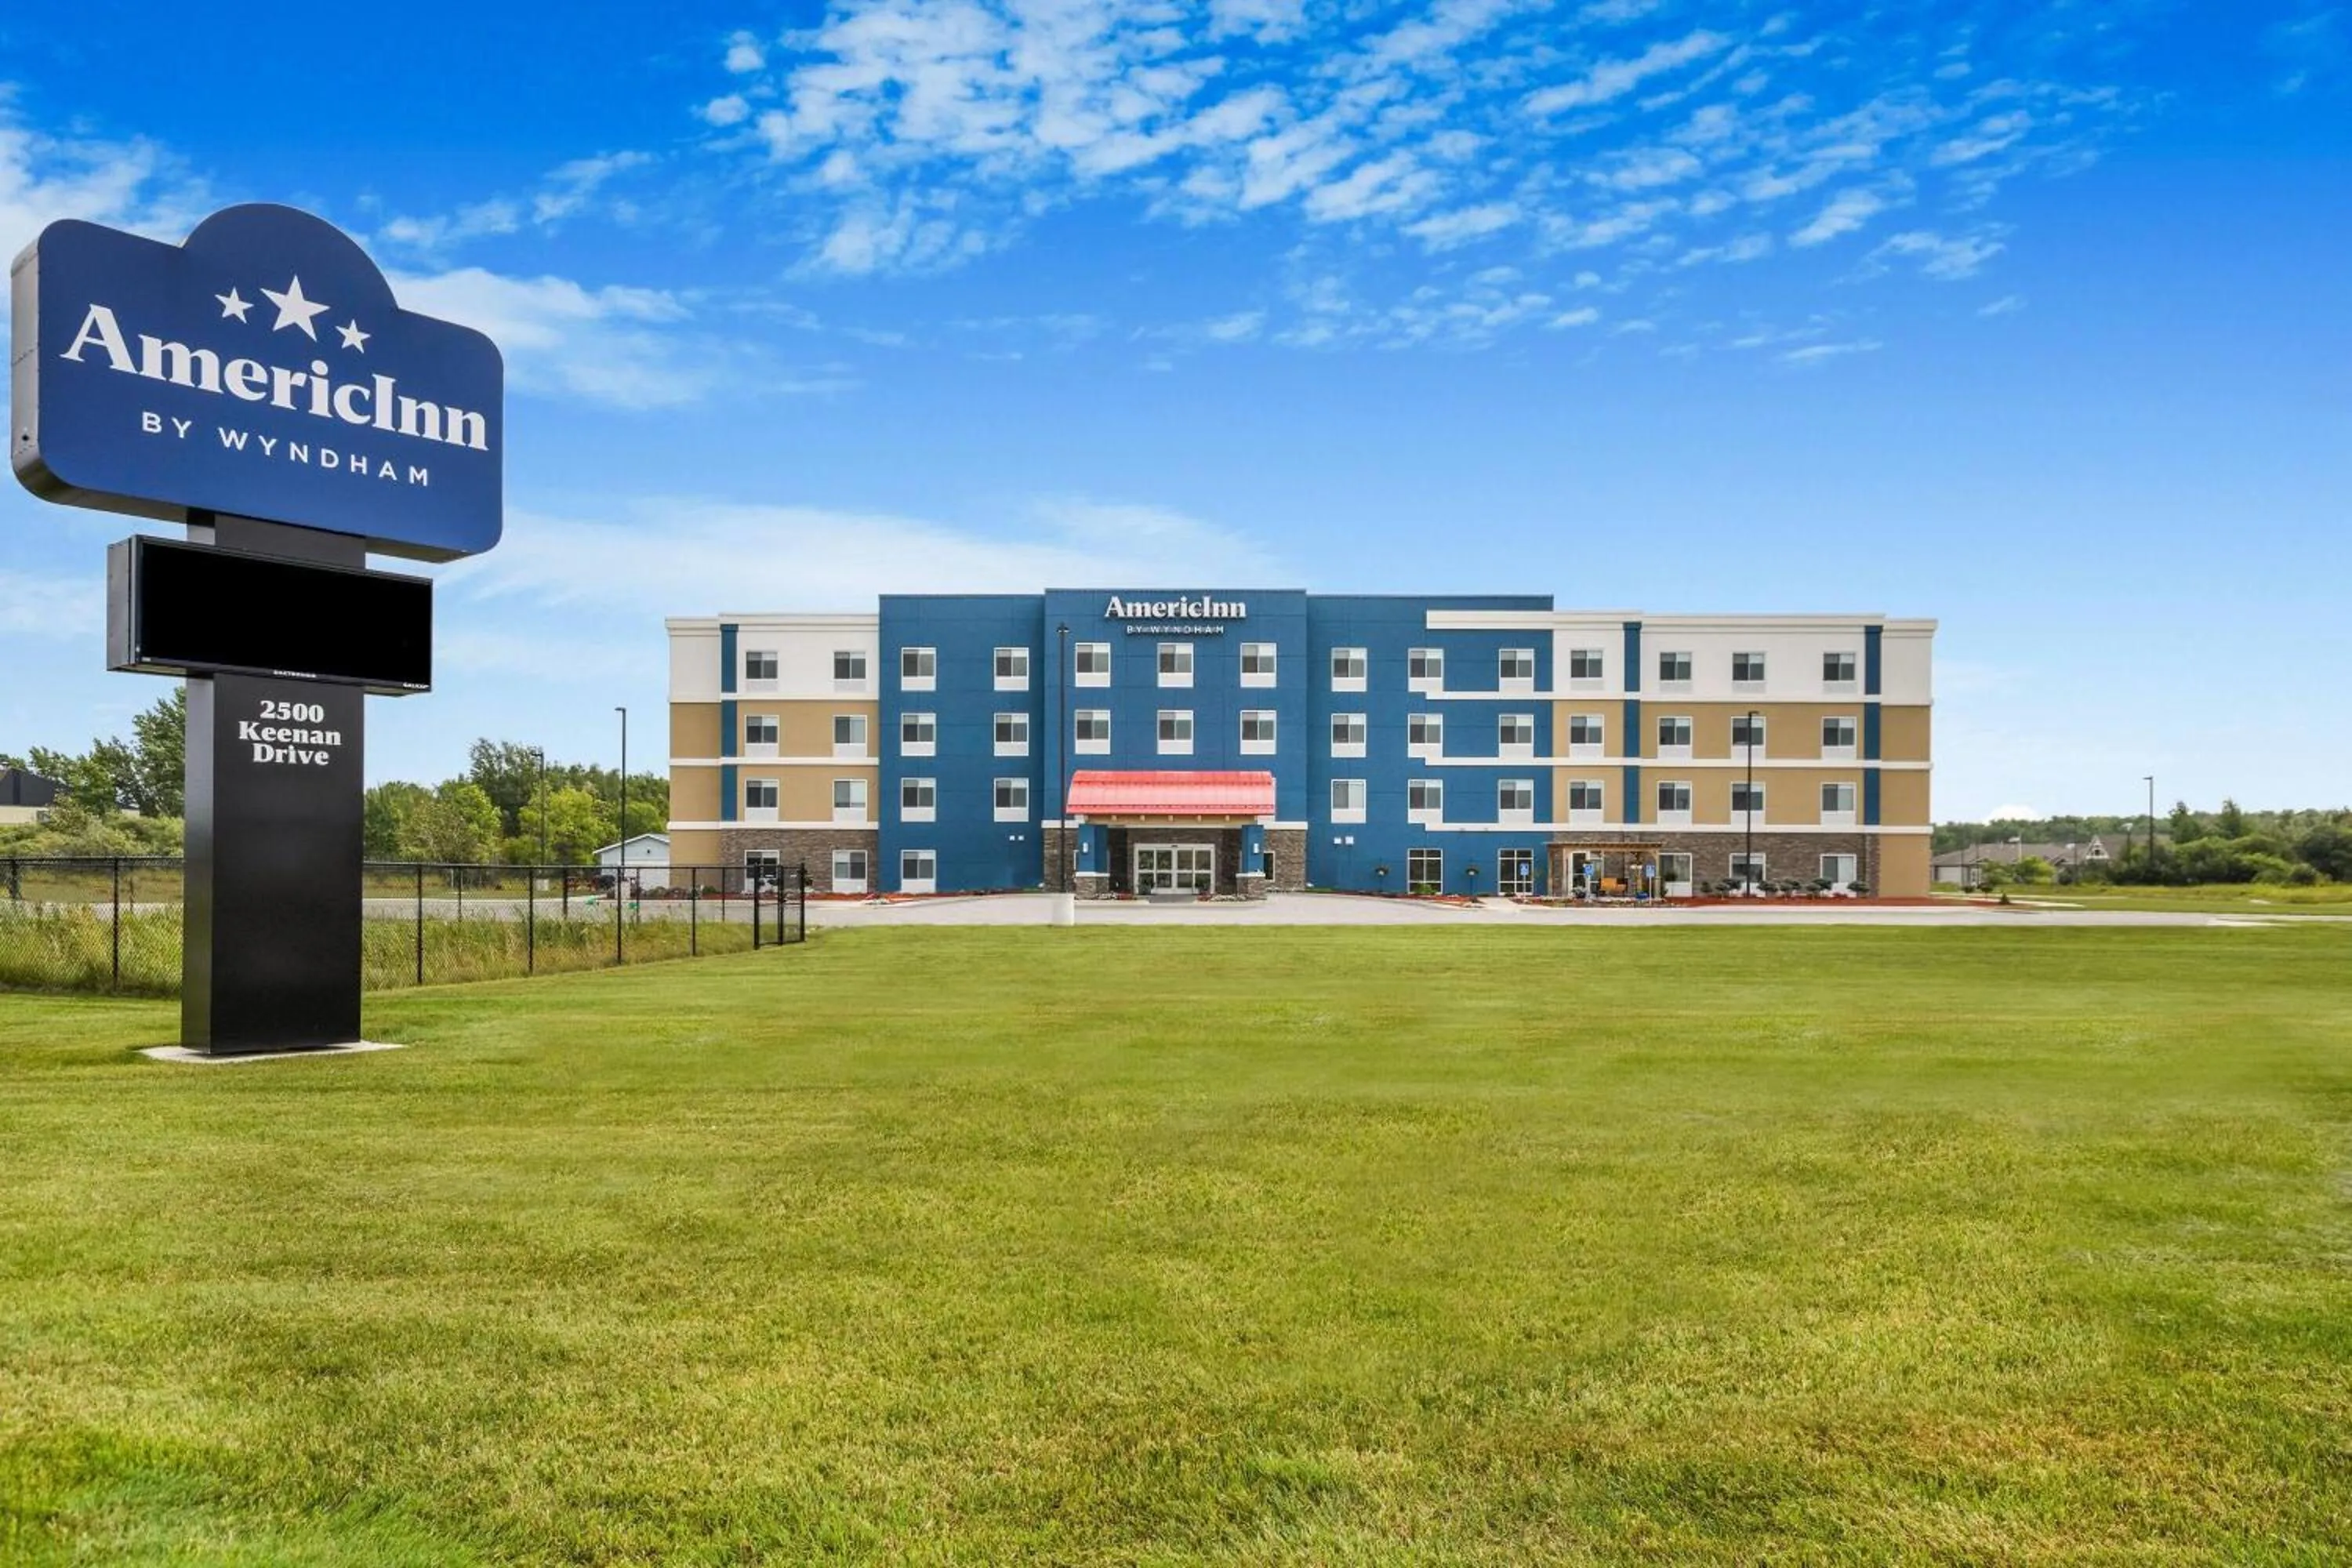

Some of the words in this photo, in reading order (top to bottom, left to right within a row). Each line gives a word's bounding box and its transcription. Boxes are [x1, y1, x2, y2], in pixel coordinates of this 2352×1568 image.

[60, 303, 488, 451] AmericInn
[142, 412, 192, 439] BY
[218, 426, 428, 487] WYNDHAM
[1104, 595, 1247, 618] AmericInn
[260, 699, 325, 724] 2500
[238, 720, 342, 746] Keenan
[252, 742, 329, 766] Drive
